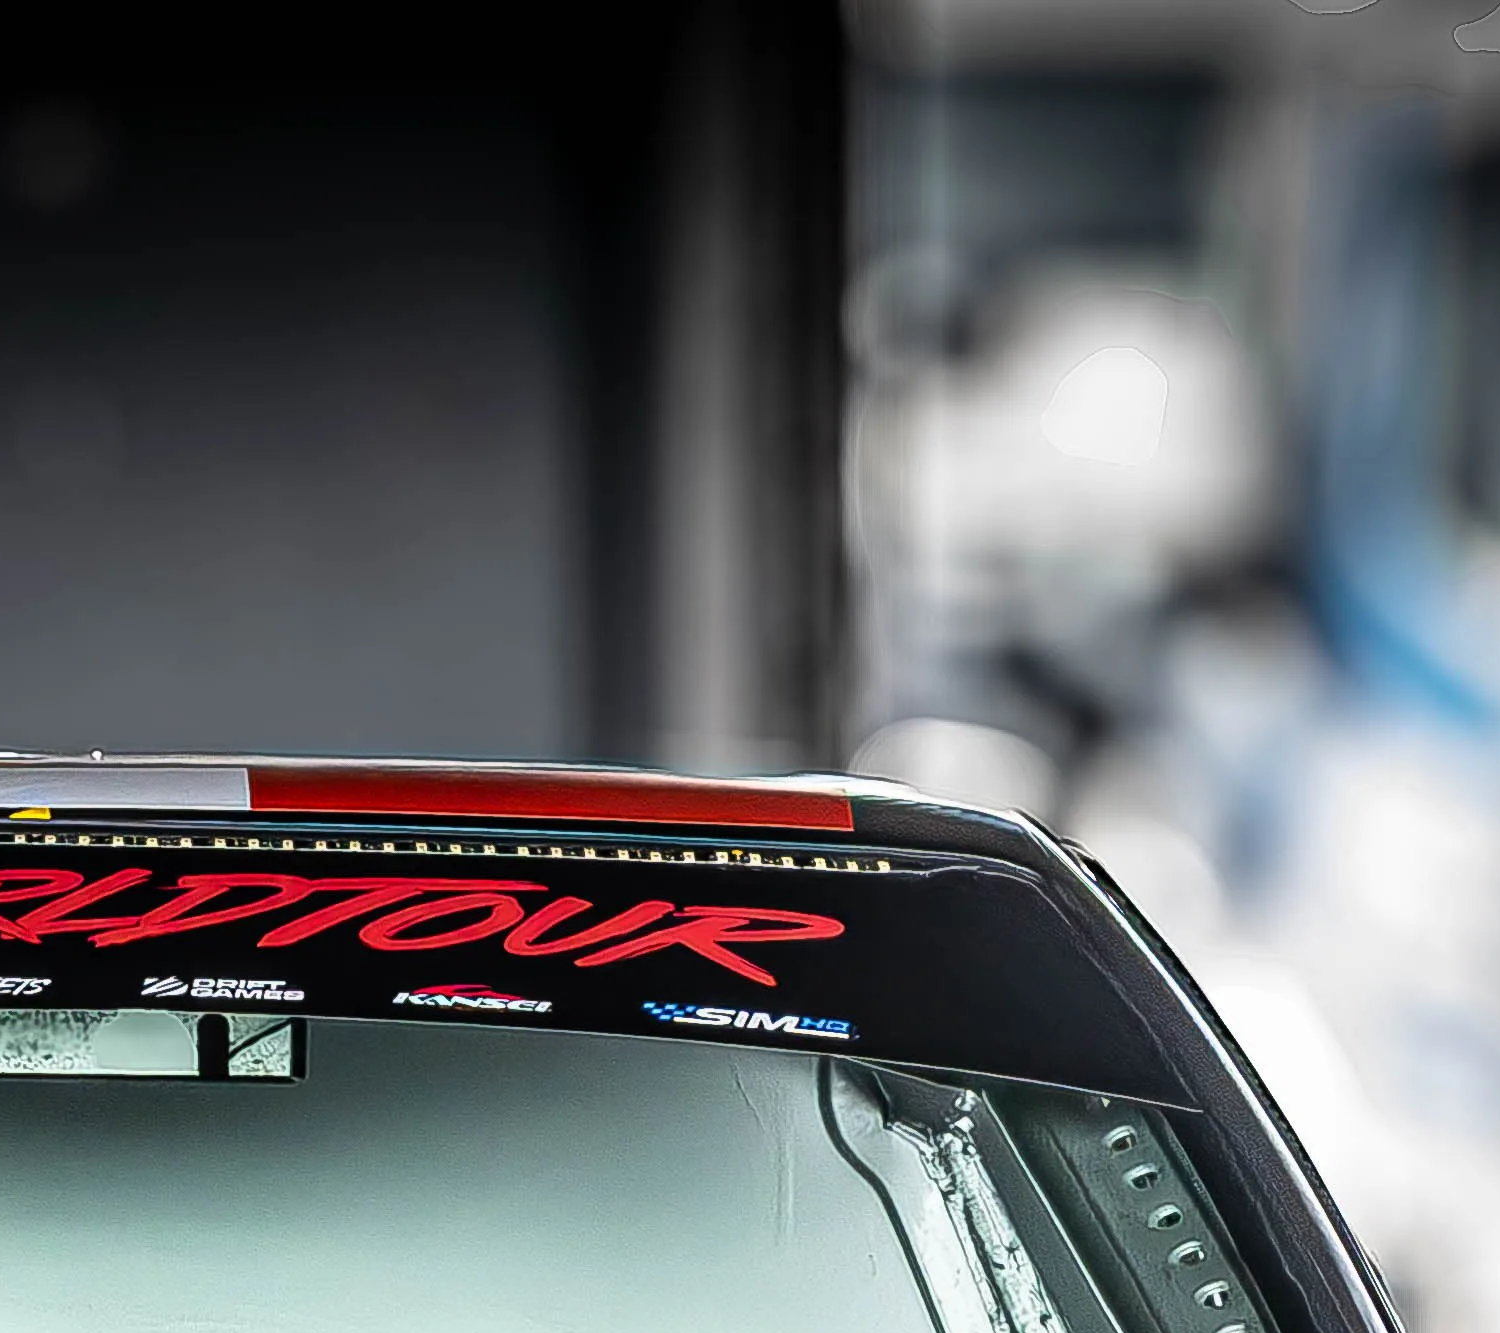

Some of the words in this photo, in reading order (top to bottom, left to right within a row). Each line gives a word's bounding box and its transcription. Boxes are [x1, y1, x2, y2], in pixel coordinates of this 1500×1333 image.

[191, 977, 287, 991] DRIFT
[189, 987, 305, 1001] GAMES
[392, 991, 553, 1013] KANSEI
